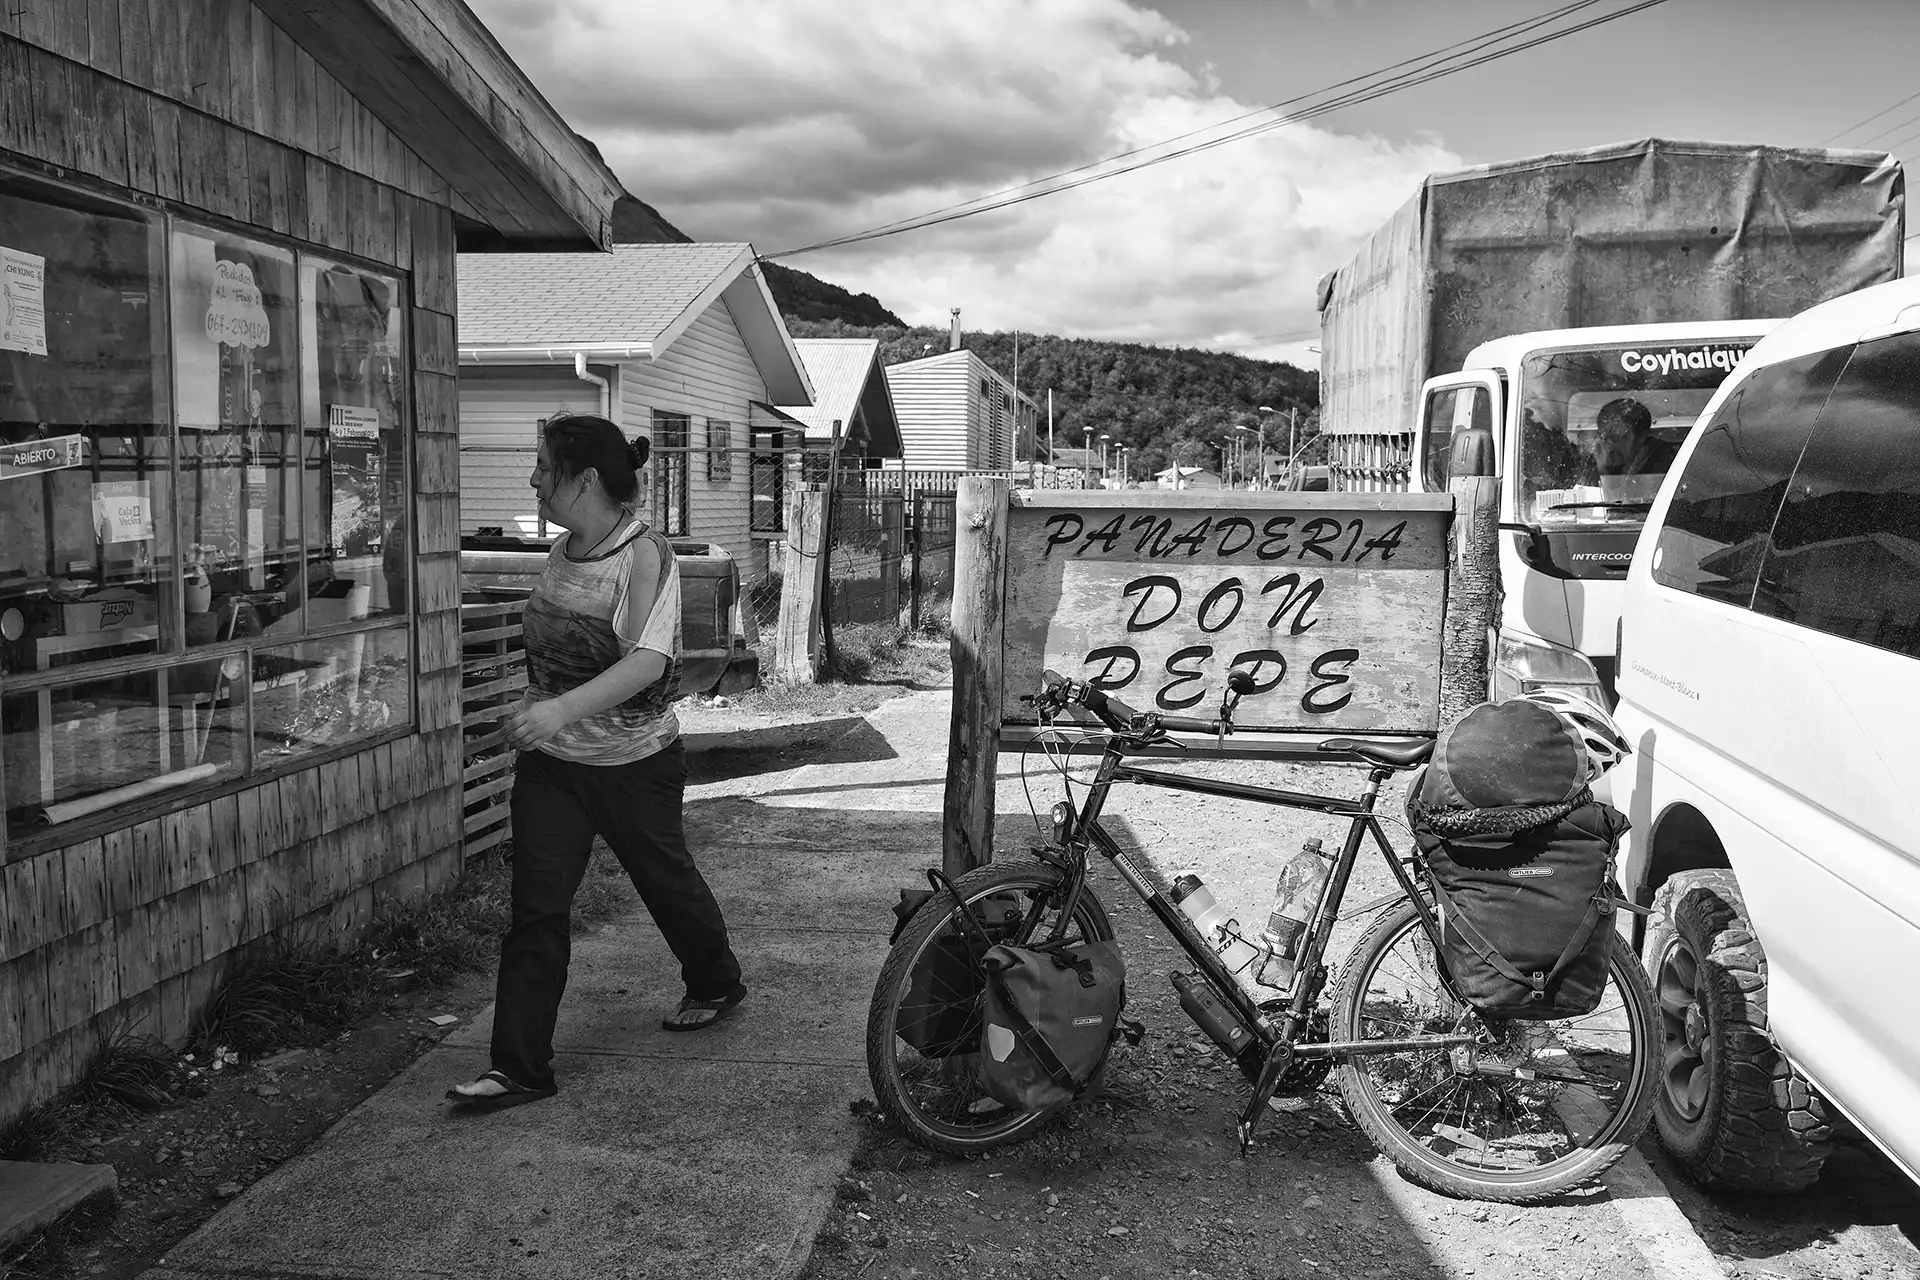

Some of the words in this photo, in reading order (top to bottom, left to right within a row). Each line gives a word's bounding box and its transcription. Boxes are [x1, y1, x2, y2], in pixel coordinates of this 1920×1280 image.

[6, 265, 17, 274] CHI
[18, 267, 35, 279] KUNG
[1620, 346, 1749, 376] Coyhaiqu
[13, 448, 56, 466] ABIERTO
[1044, 513, 1408, 563] PANADERIA
[1122, 573, 1325, 636] DON
[1084, 645, 1360, 714] PEPE
